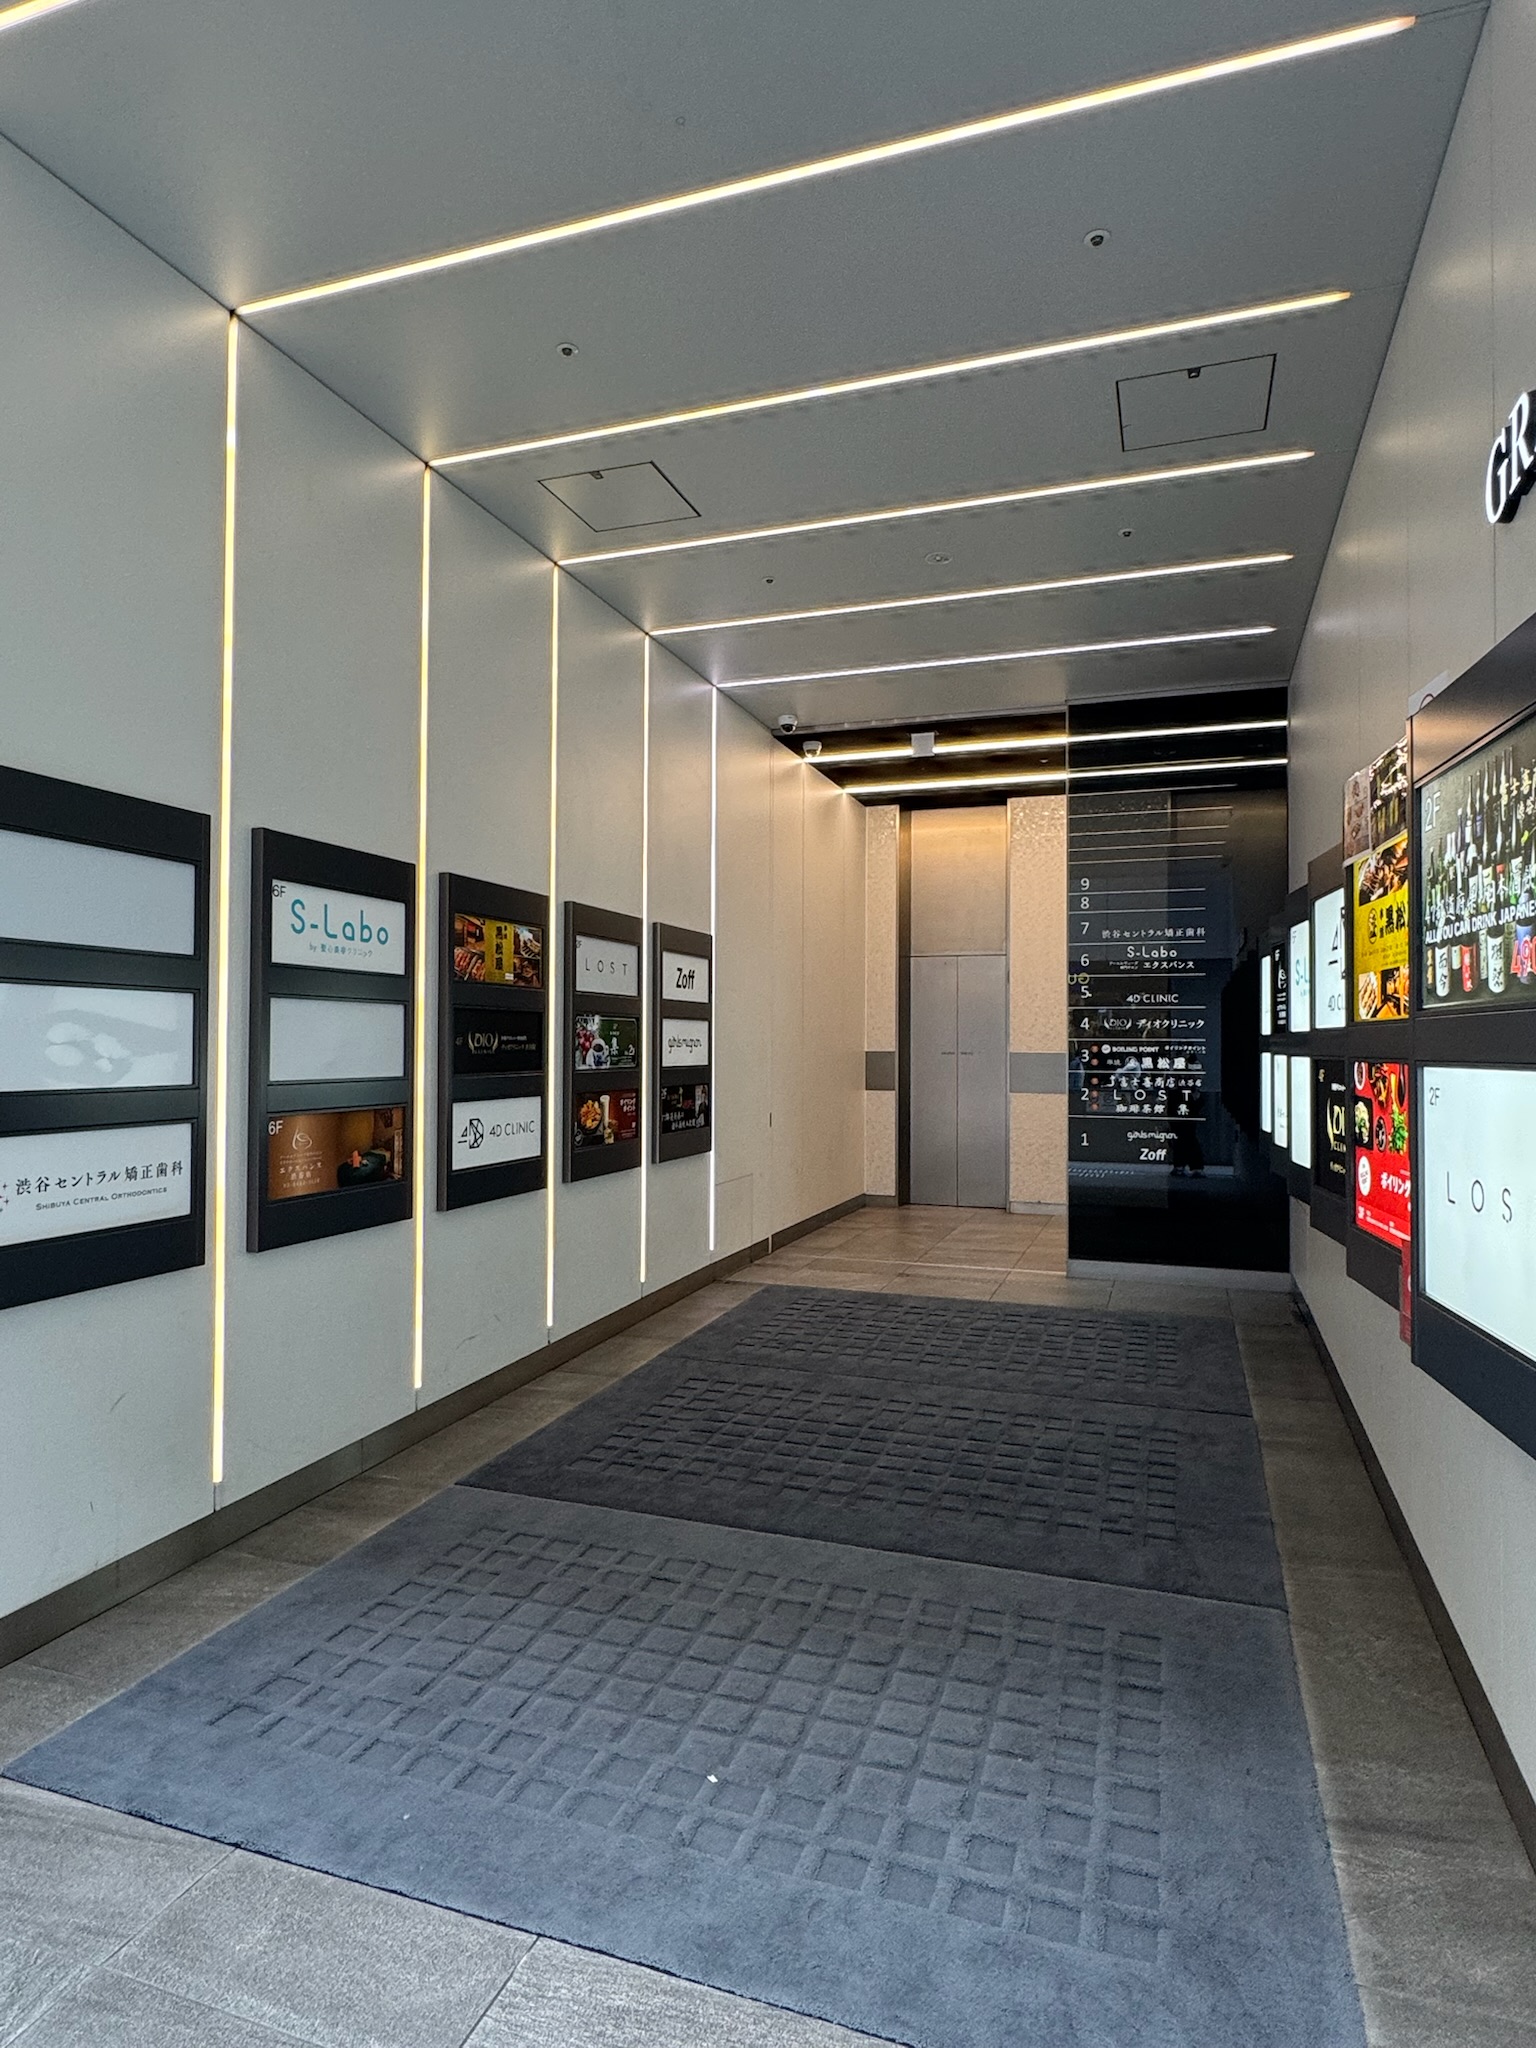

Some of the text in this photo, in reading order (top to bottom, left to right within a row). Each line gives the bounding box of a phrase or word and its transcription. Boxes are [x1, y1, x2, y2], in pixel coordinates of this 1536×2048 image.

[1485, 391, 1536, 524] GR
[1424, 790, 1441, 833] 2F
[271, 884, 286, 897] 6F
[1081, 877, 1090, 891] 9
[1081, 896, 1090, 910] 8
[291, 899, 389, 945] S-Labo
[1081, 922, 1090, 935] 7
[1454, 918, 1471, 937] CAN
[1471, 911, 1497, 932] DRINK
[1102, 927, 1206, 939] 渋谷セントラル矯正歯科
[1127, 946, 1178, 958] S-Labo
[585, 957, 628, 976] LOST
[1081, 954, 1090, 967] 6
[676, 967, 695, 990] Zoff
[1081, 985, 1089, 999] 5
[1126, 994, 1179, 1003] 4D CLINIC
[1080, 1017, 1090, 1030] 4
[1081, 1049, 1090, 1062] 3
[1081, 1087, 1090, 1101] 2
[1113, 1089, 1192, 1101] LOST
[1429, 1087, 1440, 1106] 2F
[268, 1120, 284, 1135] 6F
[489, 1120, 535, 1137] 4D CLINIC
[1081, 1133, 1089, 1146] 1
[1140, 1148, 1167, 1160] Zoff
[15, 1160, 184, 1196] 渋谷セントラル矯正歯科
[1447, 1170, 1513, 1224] LOS
